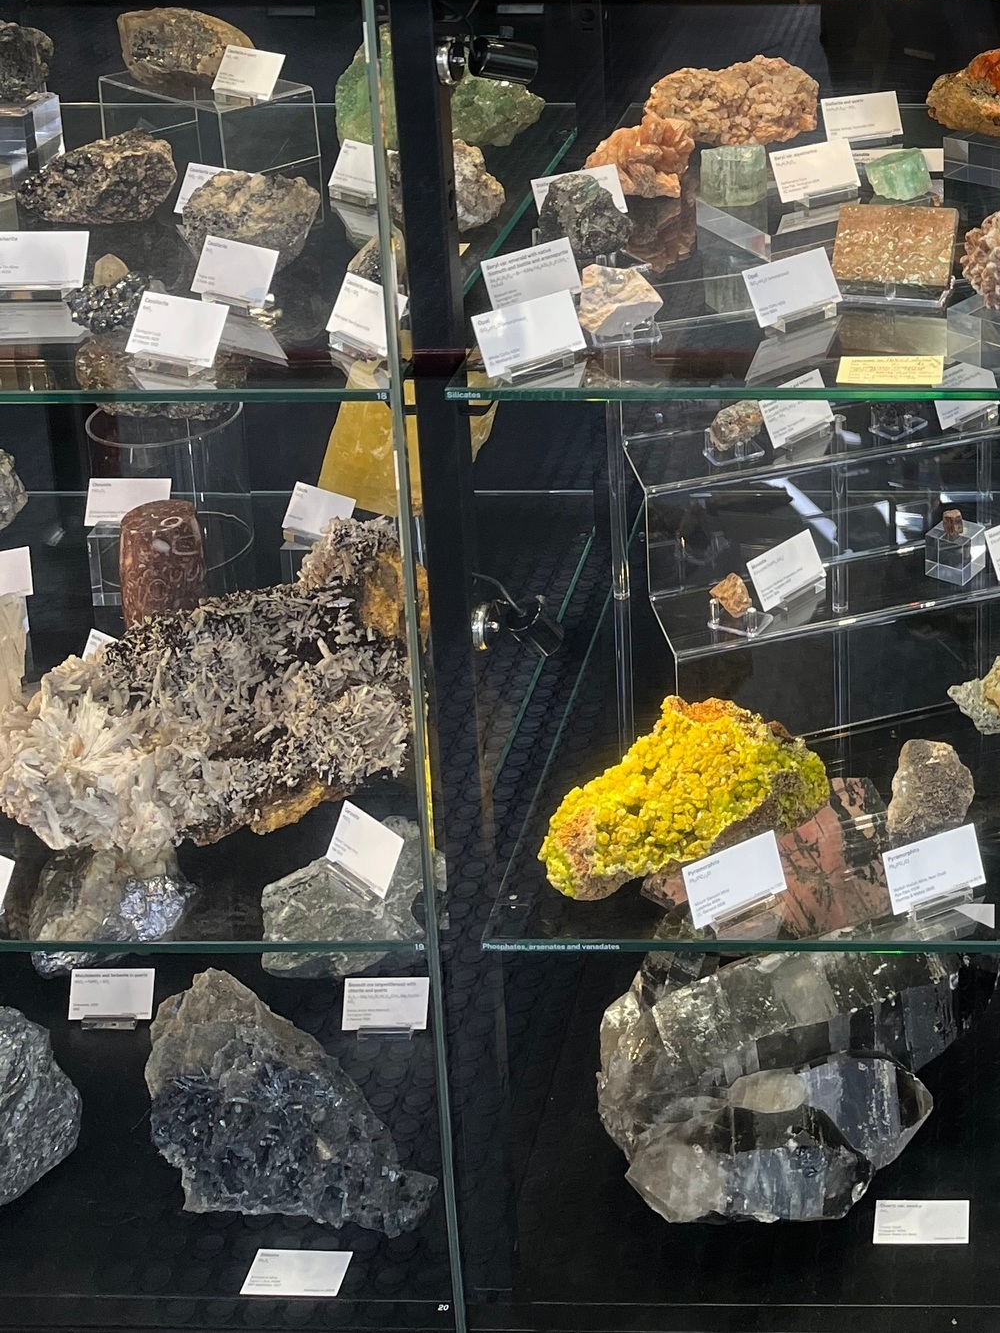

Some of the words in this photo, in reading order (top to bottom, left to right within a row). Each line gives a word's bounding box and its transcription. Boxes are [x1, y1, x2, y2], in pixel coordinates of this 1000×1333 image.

[376, 391, 388, 400] 18
[414, 943, 425, 951] 19
[482, 942, 527, 952] Phosphates,
[529, 943, 566, 951] arsenates
[567, 942, 581, 951] and
[582, 942, 620, 951] vanadates
[437, 1303, 450, 1312] 20
